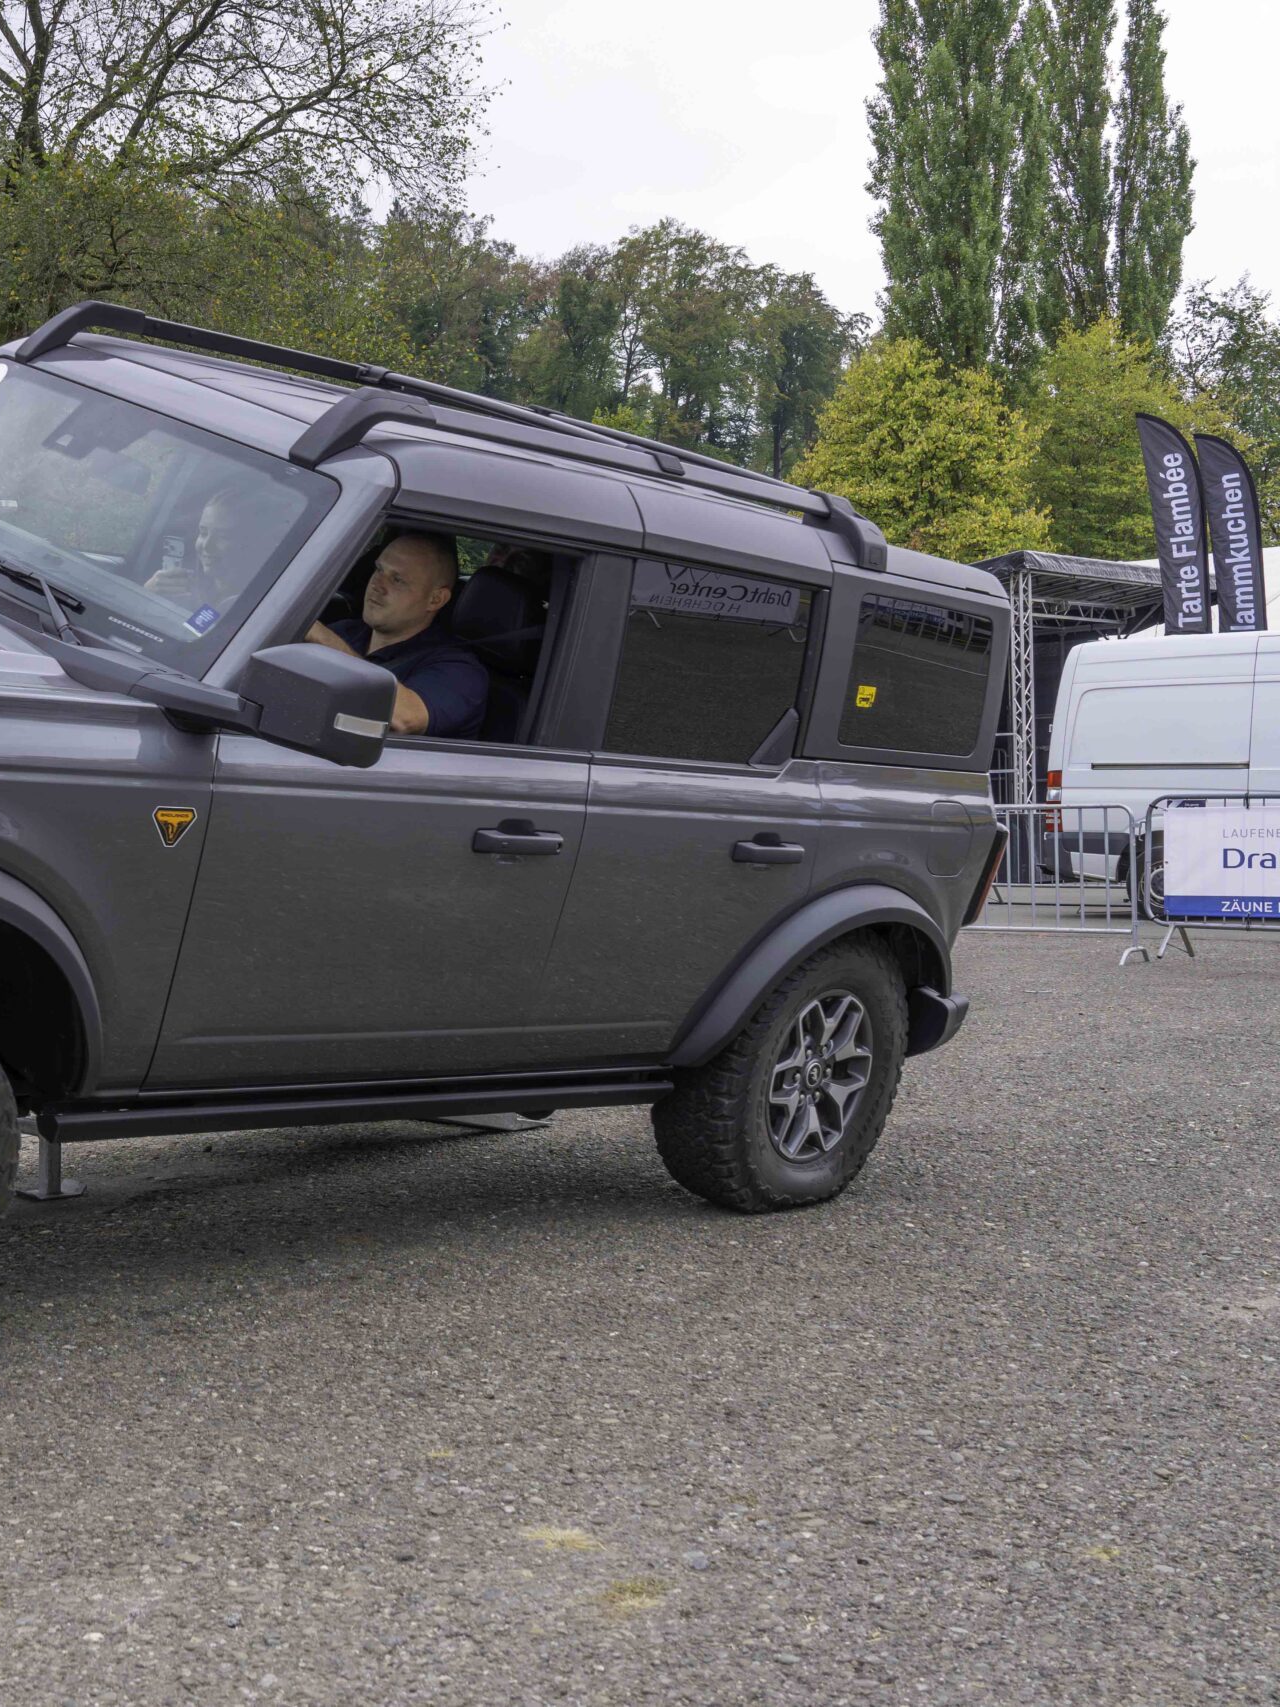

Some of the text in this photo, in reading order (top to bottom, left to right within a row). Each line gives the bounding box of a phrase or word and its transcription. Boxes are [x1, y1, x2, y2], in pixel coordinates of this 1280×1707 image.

[1159, 452, 1203, 628] Tarte Flambée
[1223, 848, 1277, 869] Dra
[1221, 899, 1273, 913] ZÄUNE
